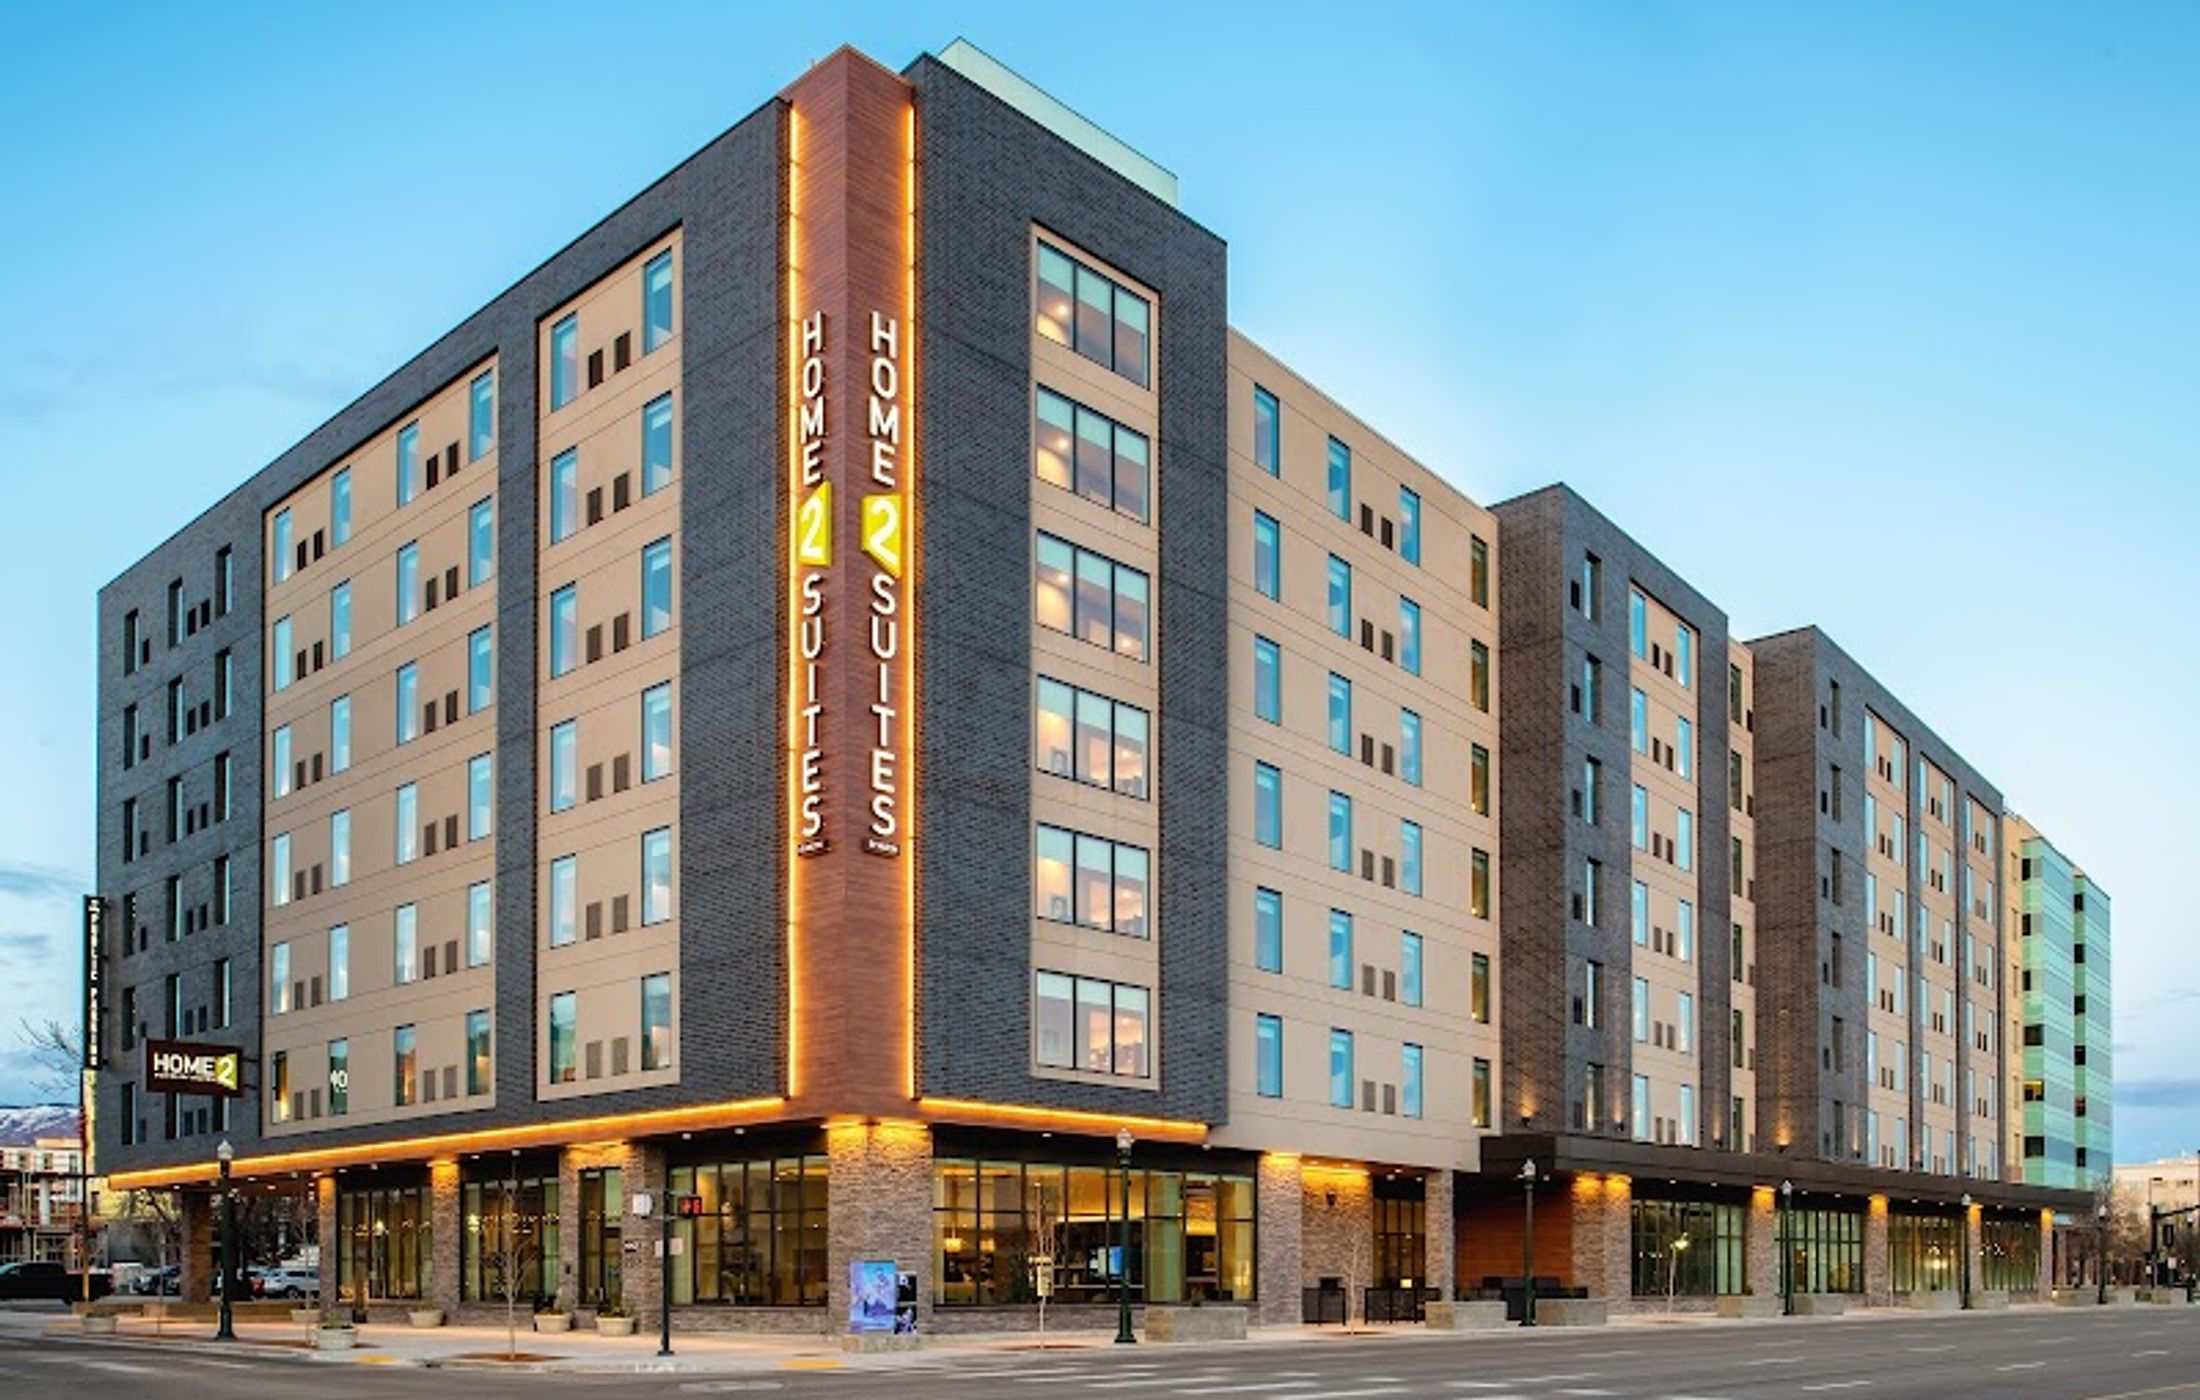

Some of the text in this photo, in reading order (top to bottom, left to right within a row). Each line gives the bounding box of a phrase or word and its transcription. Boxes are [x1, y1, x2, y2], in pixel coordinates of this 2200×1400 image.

[800, 310, 824, 486] HOME
[869, 310, 899, 486] HOME
[800, 496, 824, 557] 2
[869, 498, 899, 567] 2
[802, 573, 821, 837] SUITES
[871, 572, 896, 836] SUITES
[153, 1052, 237, 1090] HOME 2
